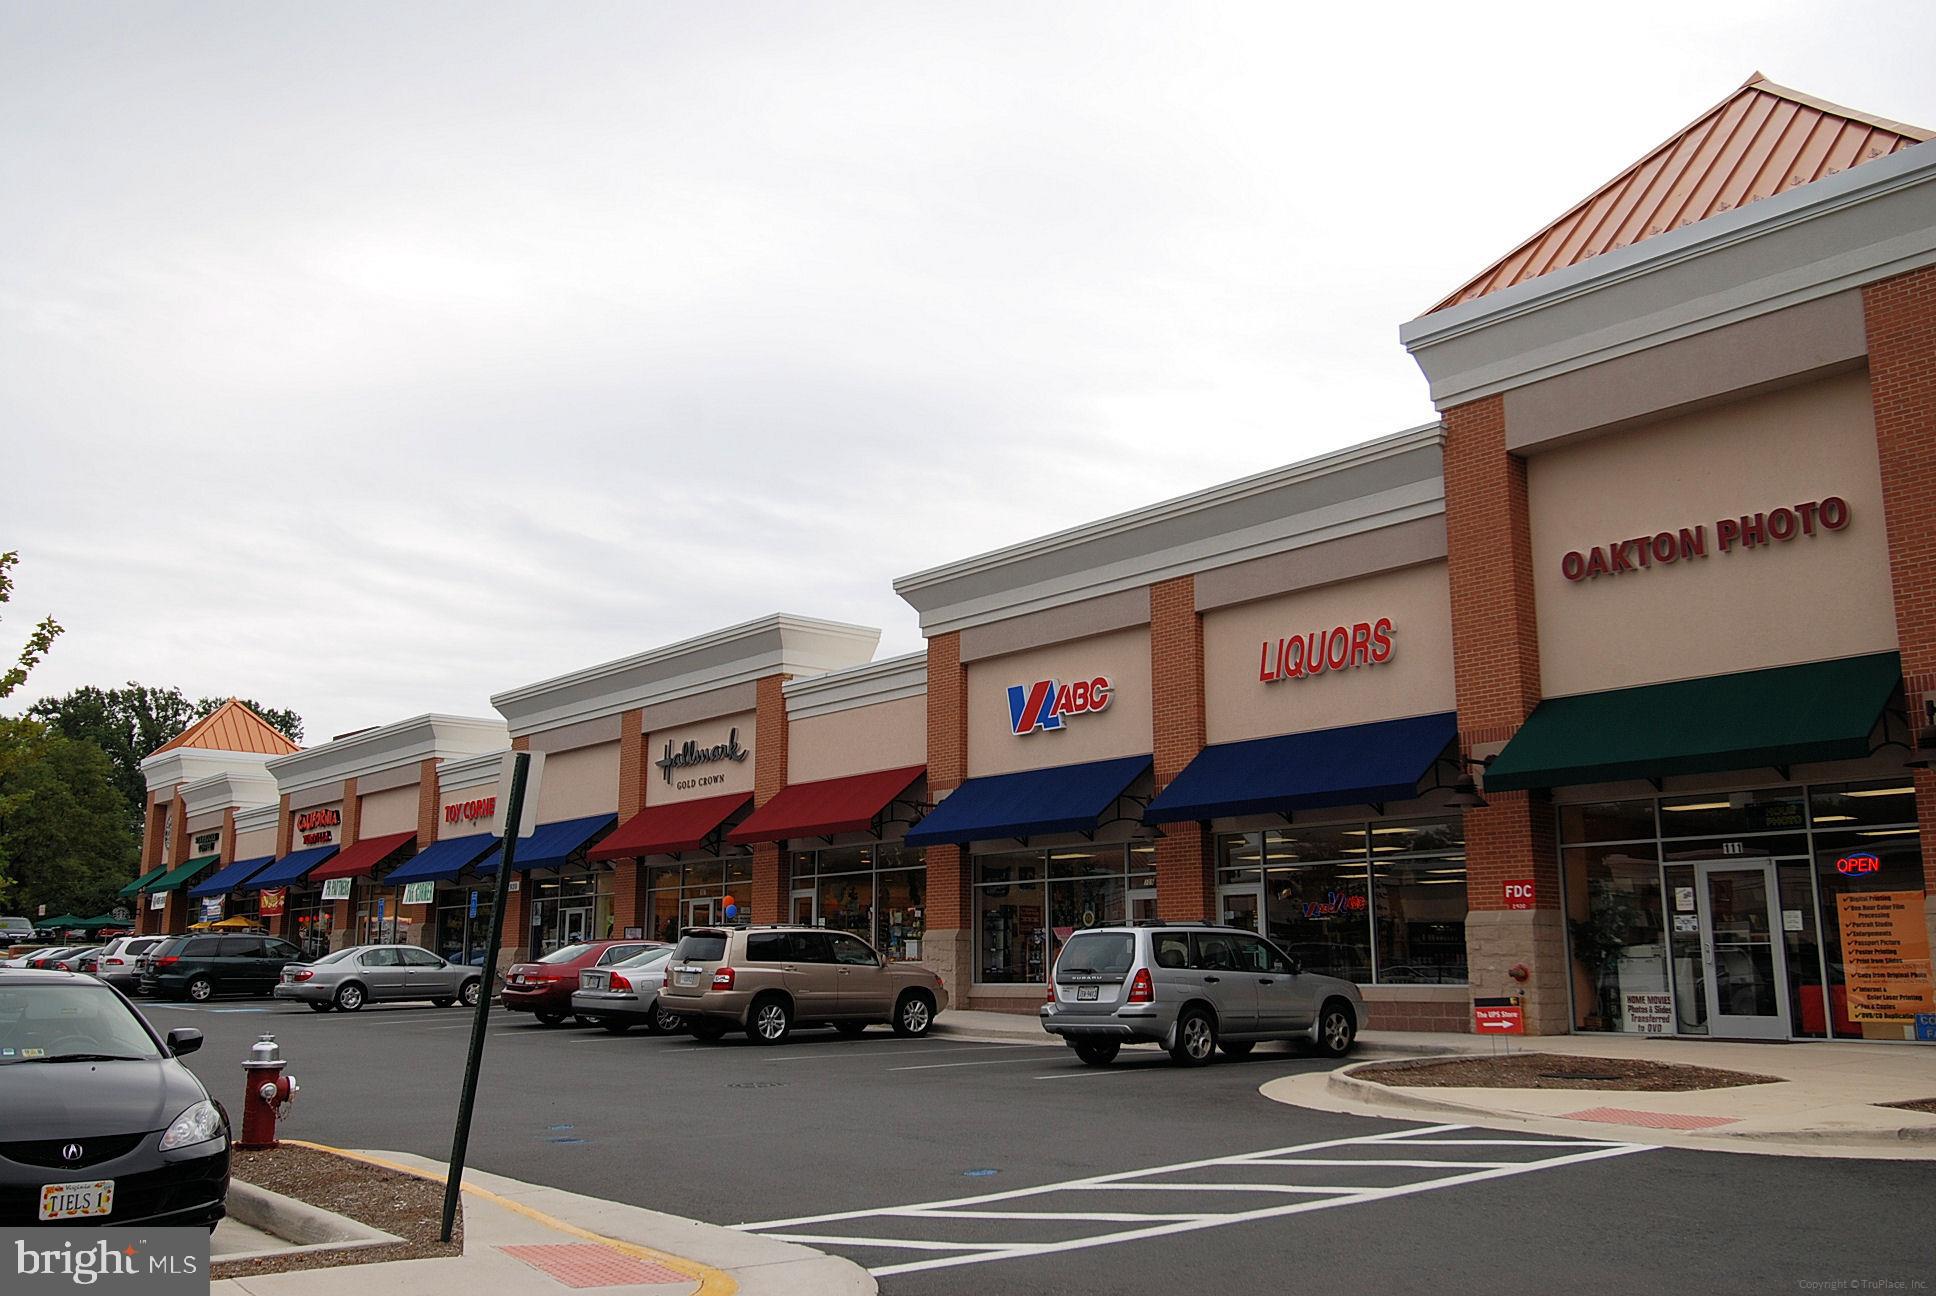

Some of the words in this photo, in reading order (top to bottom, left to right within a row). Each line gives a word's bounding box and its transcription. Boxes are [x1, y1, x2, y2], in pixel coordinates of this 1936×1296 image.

[1561, 524, 1708, 582] OAKTON
[1716, 496, 1851, 553] PHOTO
[1260, 617, 1396, 683] LIQUORS
[1048, 675, 1112, 718] ABC
[655, 727, 749, 785] Hallmark
[676, 779, 696, 790] GOLD
[698, 774, 725, 787] CROWN
[444, 803, 463, 823] TOY
[463, 796, 497, 820] CORNE
[297, 808, 341, 832] CALIFORNIA
[1723, 843, 1742, 853] 111
[1836, 857, 1879, 873] OPEN
[1505, 884, 1533, 898] FDC
[1626, 995, 1646, 1004] HOME
[1647, 995, 1671, 1004] MOVIES
[1627, 1005, 1648, 1013] Photos
[1654, 1005, 1672, 1014] Slides
[1631, 1013, 1670, 1023] Transferred
[1647, 1023, 1662, 1032] DVD
[65, 1184, 91, 1192] Virginia
[50, 1192, 91, 1212] TIELS
[96, 1192, 103, 1208] 1
